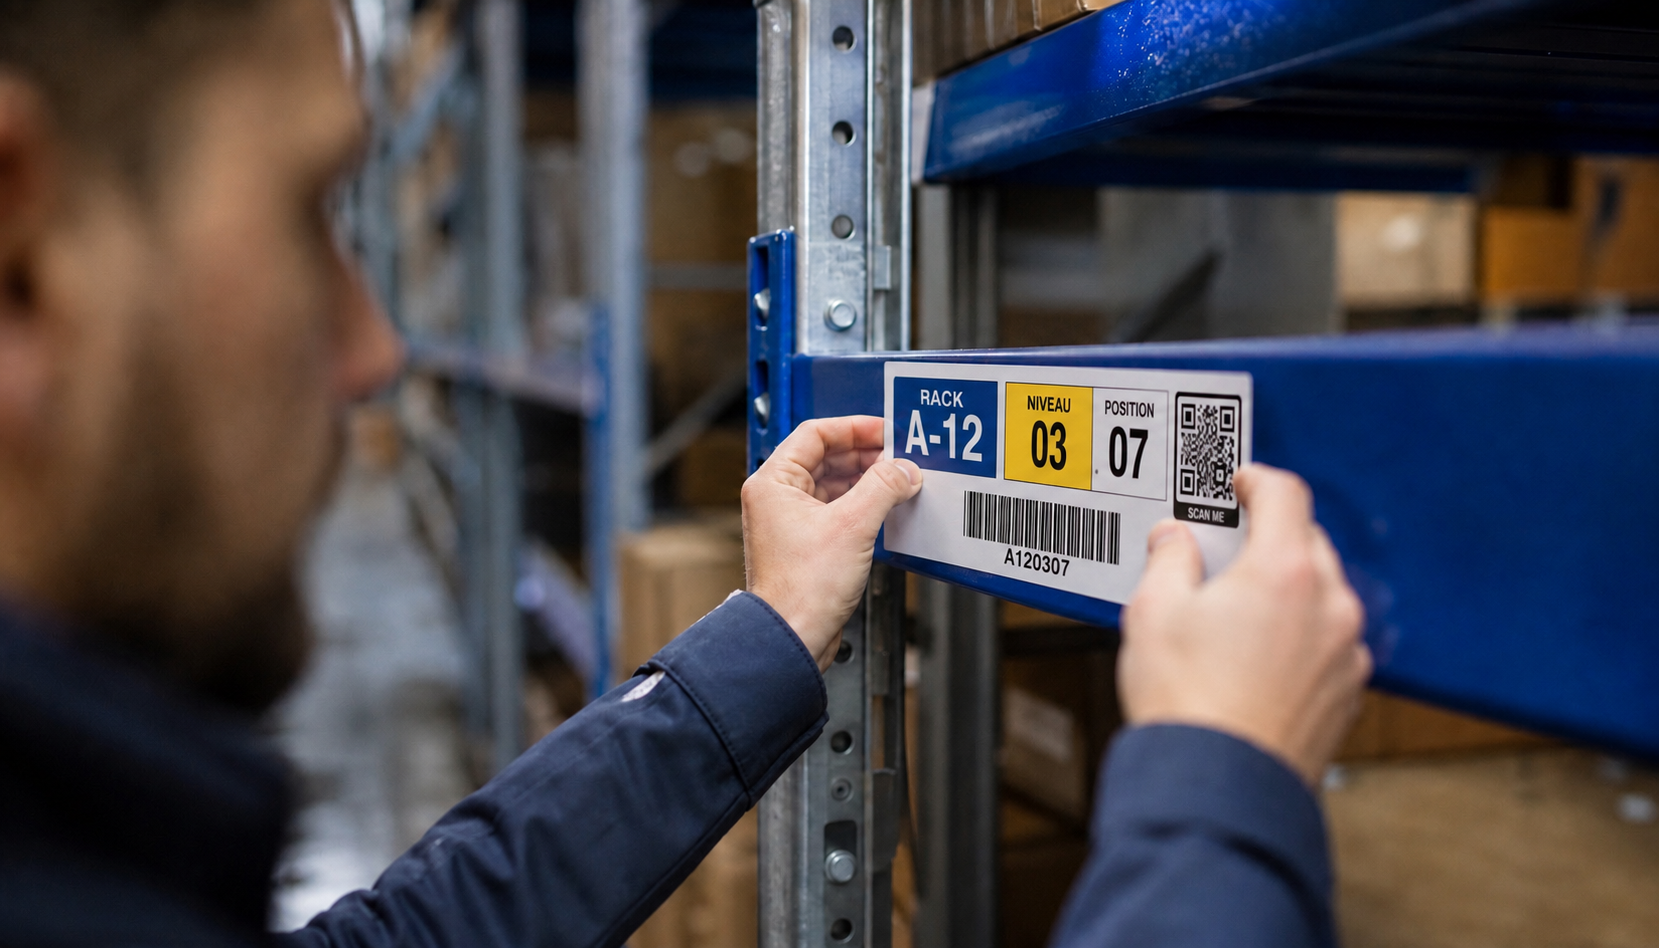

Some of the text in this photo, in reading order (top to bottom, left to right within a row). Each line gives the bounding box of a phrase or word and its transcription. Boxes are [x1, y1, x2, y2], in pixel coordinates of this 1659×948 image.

[920, 389, 964, 409] RACK
[1027, 395, 1071, 414] NIVEAU
[1104, 399, 1155, 419] POSITION
[904, 409, 983, 463] A-12
[1031, 420, 1067, 471] 03
[1108, 426, 1149, 480] 07
[1187, 506, 1225, 523] SCAN ME
[1004, 547, 1070, 577] A120307
